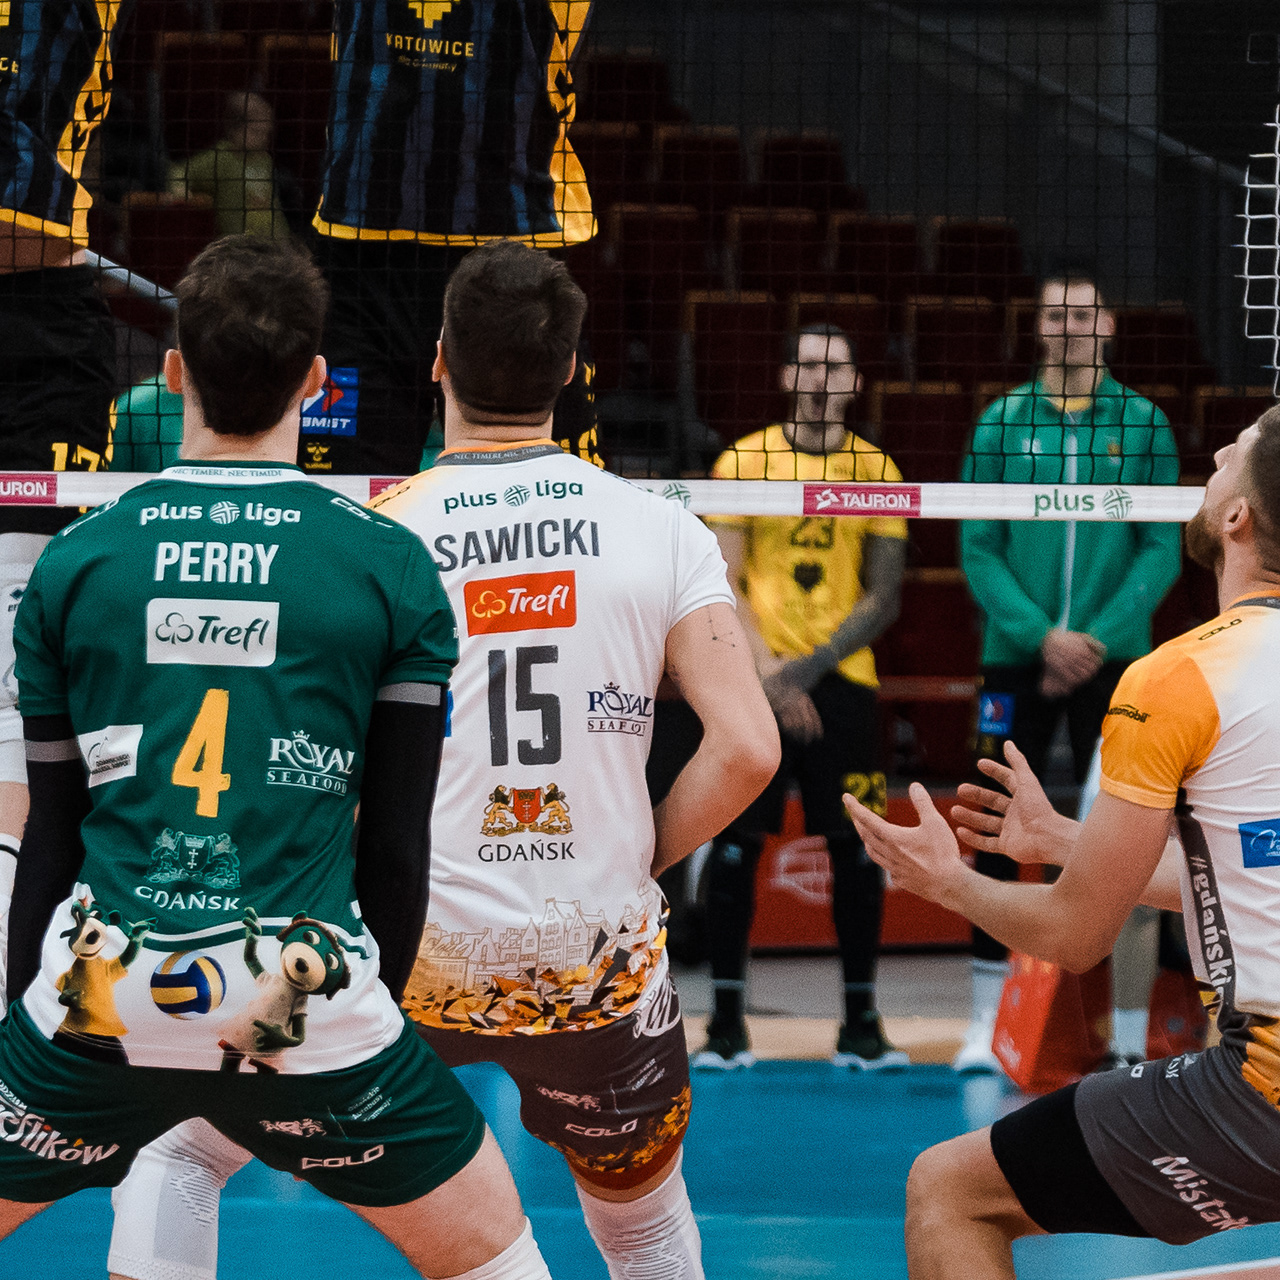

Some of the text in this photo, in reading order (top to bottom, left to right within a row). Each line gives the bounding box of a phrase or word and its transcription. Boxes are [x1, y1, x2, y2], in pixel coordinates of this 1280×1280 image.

[386, 33, 475, 57] KATOWICE
[444, 479, 584, 515] plus liga
[839, 492, 912, 510] TAURON
[1035, 488, 1095, 518] plus
[140, 502, 302, 526] plus liga
[433, 517, 600, 572] SAWICKI
[154, 541, 279, 585] PERRY
[508, 583, 572, 618] Trefl
[194, 615, 271, 653] Trefl
[487, 645, 562, 767] 15
[586, 689, 653, 718] ROYAL
[171, 688, 231, 819] 4
[268, 737, 355, 774] ROYAL
[267, 770, 347, 794] SEAFOOD
[477, 839, 576, 863] GDAŃSK
[134, 883, 241, 912] GDAŃSK
[565, 1118, 639, 1137] COLO
[301, 1144, 385, 1170] COLO
